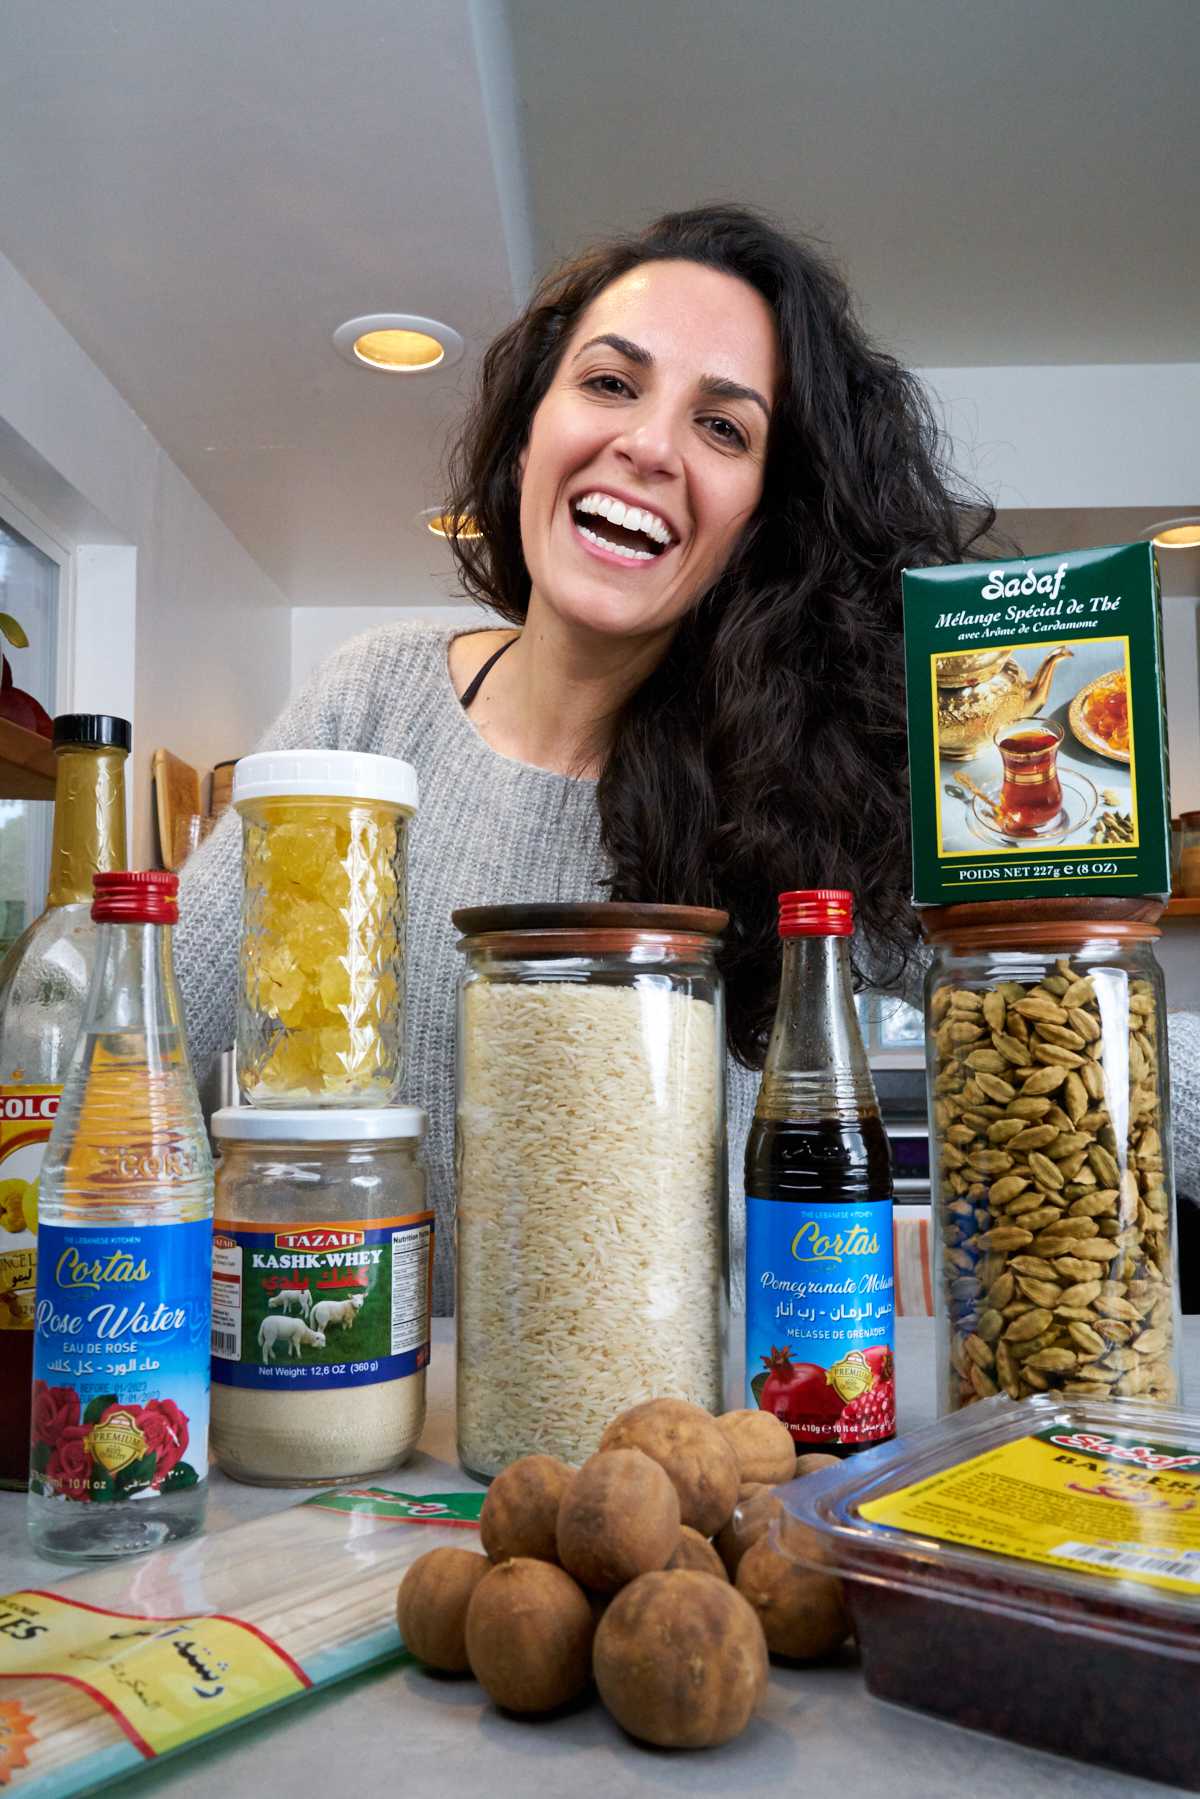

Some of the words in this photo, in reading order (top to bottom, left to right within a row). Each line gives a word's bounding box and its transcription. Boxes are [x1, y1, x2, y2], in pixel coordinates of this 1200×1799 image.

[981, 562, 1069, 600] Sadaf
[935, 611, 1001, 629] Mélange
[1005, 600, 1061, 623] Spécial
[1066, 599, 1084, 615] de
[1089, 596, 1122, 612] Thé
[957, 631, 980, 641] avec
[981, 627, 1016, 638] Arôme
[1018, 623, 1030, 634] de
[1032, 619, 1098, 633] Cardamome
[959, 868, 1000, 880] POIDS
[1004, 866, 1030, 878] NET
[1033, 866, 1060, 878] 227g
[1077, 864, 1089, 876] (8
[1092, 862, 1118, 874] OZ)
[284, 1233, 356, 1247] TAZAH
[791, 1221, 879, 1263] Cortas
[252, 1249, 383, 1269] KASHK-WHEY
[56, 1247, 151, 1291] Cortas
[760, 1272, 857, 1299] Pomegranate
[36, 1299, 83, 1338] Rose
[87, 1301, 186, 1339] Water
[830, 1302, 872, 1321] الرمان
[832, 1330, 844, 1339] DE
[63, 1343, 84, 1353] EAU
[87, 1343, 101, 1353] DE
[105, 1343, 138, 1353] ROSE
[105, 1359, 136, 1376] الورد
[259, 1367, 273, 1376] Net
[275, 1367, 307, 1378] Weight:
[331, 1364, 346, 1375] OZ
[350, 1362, 369, 1374] (360
[370, 1360, 379, 1372] g)
[94, 1431, 142, 1446] PREMIUM
[93, 1480, 107, 1489] oz
